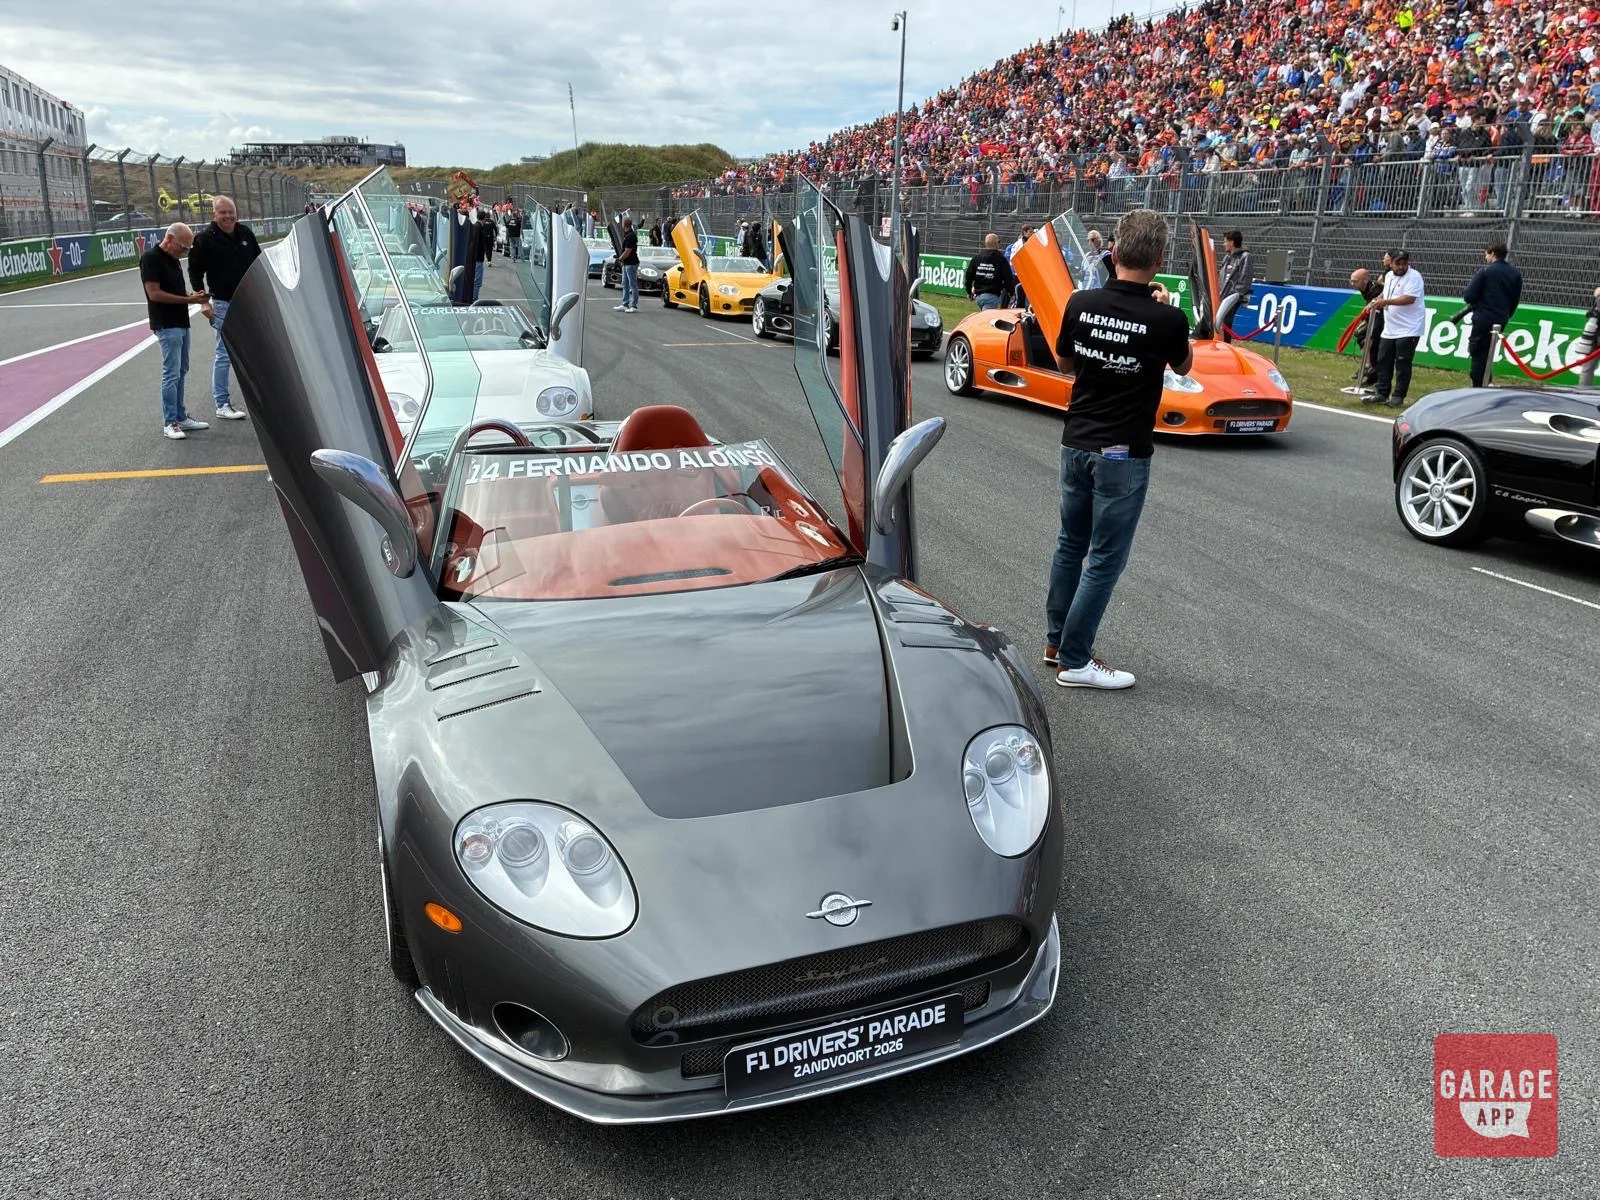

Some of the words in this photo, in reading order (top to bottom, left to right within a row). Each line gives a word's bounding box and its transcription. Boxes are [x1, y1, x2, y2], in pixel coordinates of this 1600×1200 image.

[101, 237, 136, 262] Heineken
[919, 259, 965, 289] ineken
[420, 307, 467, 315] CARLOS
[469, 306, 505, 315] SAINZ
[1079, 311, 1147, 334] ALEXANDER
[1090, 328, 1129, 344] ALBON
[1074, 344, 1108, 361] FINAL
[1109, 353, 1137, 365] LAP
[465, 461, 500, 485] 14
[507, 452, 672, 479] FERNANDO
[679, 449, 775, 469] ALONSO
[746, 1051, 770, 1074] F1
[868, 1004, 946, 1043] PARADE
[793, 1046, 871, 1078] ZANDVOORT
[873, 1037, 904, 1058] 2026
